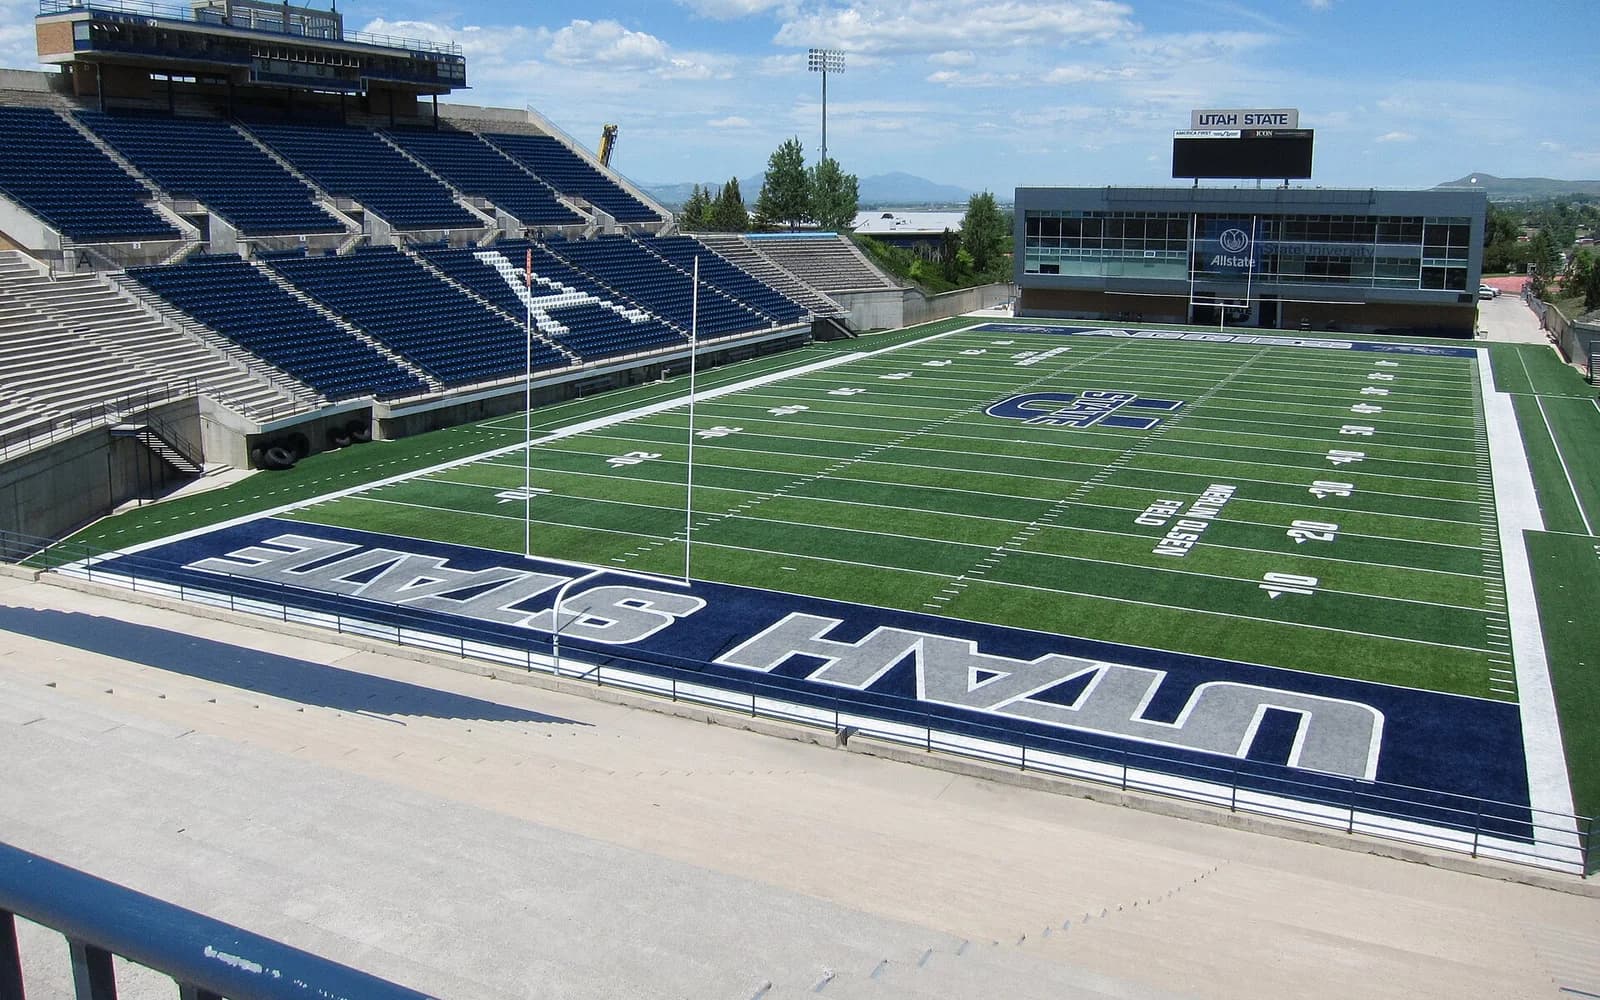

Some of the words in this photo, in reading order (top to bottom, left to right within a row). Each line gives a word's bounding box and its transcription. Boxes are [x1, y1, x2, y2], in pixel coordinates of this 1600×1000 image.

[1199, 114, 1237, 126] UTAH
[1244, 113, 1288, 125] STATE
[1210, 254, 1256, 268] Allstate
[1302, 244, 1375, 257] University
[606, 451, 662, 466] 20
[1309, 481, 1354, 497] 30
[1134, 498, 1185, 527] FIELD
[1184, 483, 1238, 520] MERLIN
[1151, 519, 1209, 558] OLSEN
[1287, 520, 1339, 542] 20
[180, 533, 708, 645] STATE
[1258, 571, 1318, 595] 10
[710, 612, 1385, 785] UTAH
